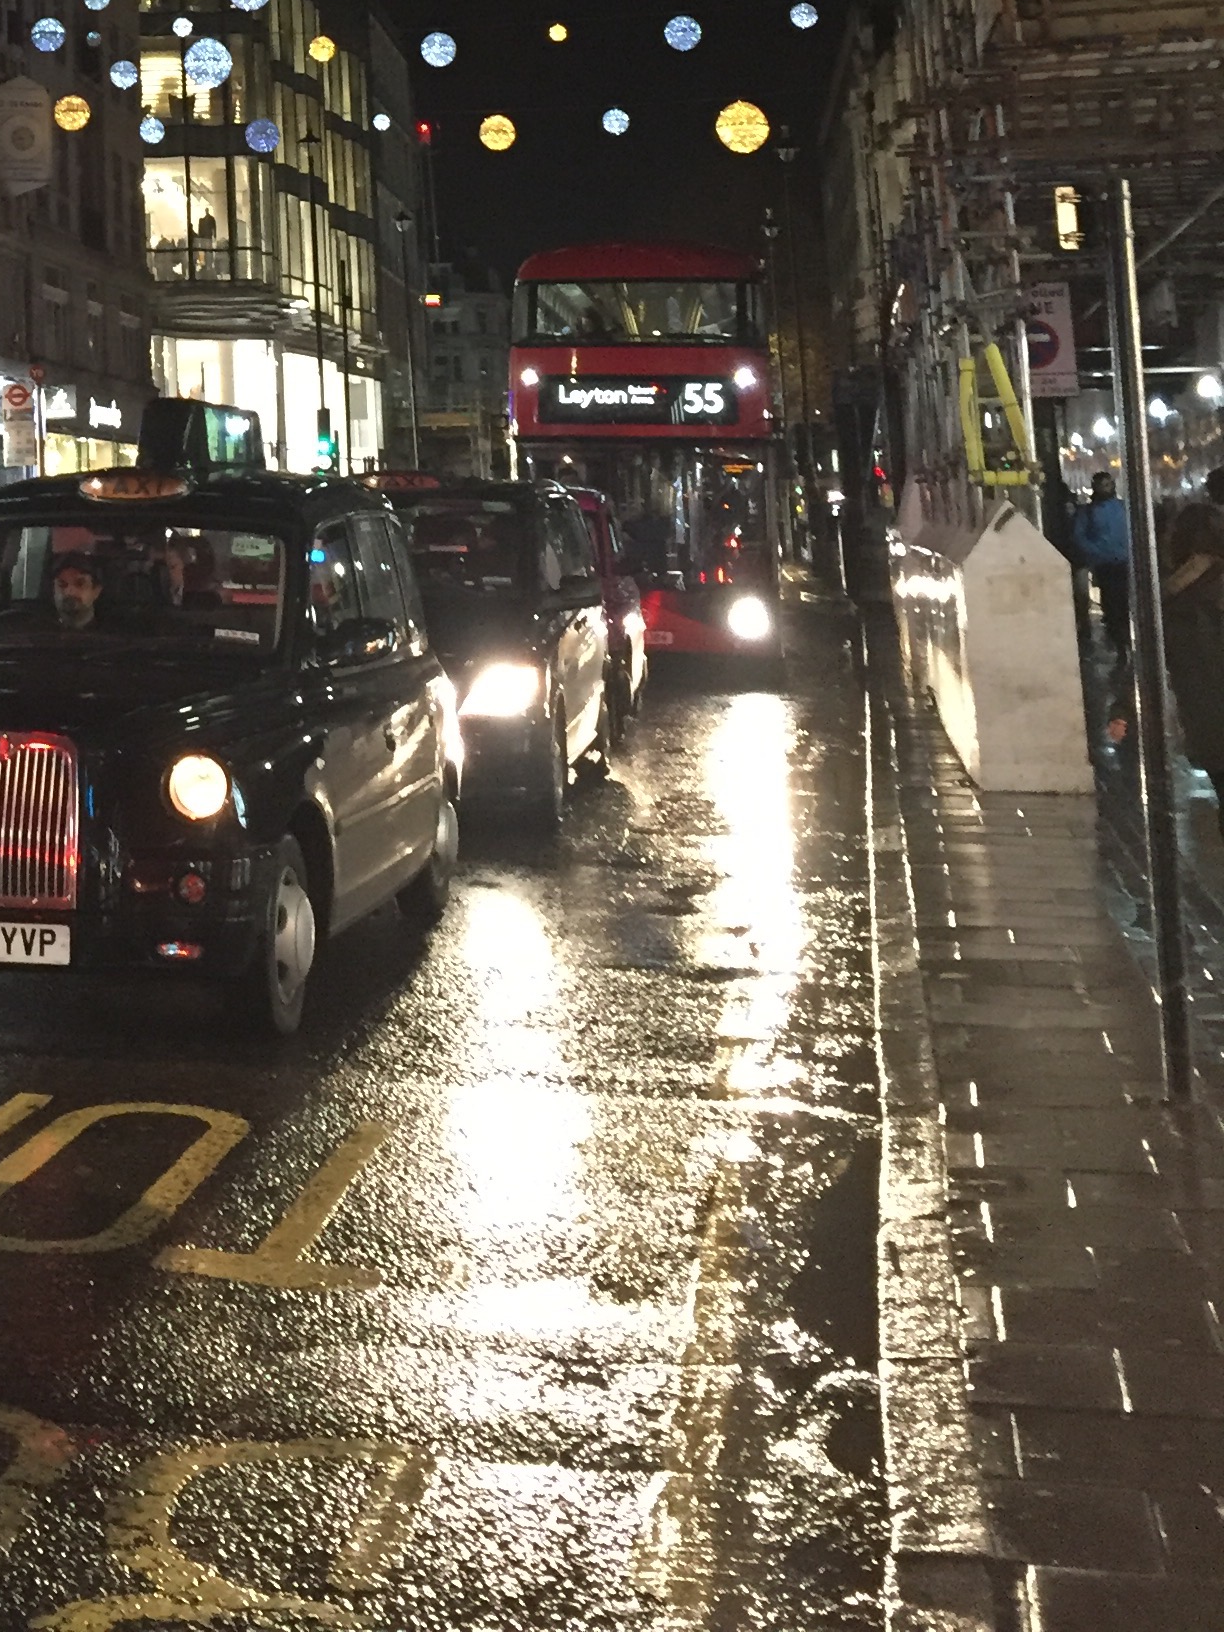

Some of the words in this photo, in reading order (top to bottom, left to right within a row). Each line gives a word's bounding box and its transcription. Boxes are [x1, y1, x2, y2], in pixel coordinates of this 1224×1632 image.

[558, 384, 628, 409] Leyton
[683, 382, 725, 414] 55
[0, 926, 57, 957] YVP
